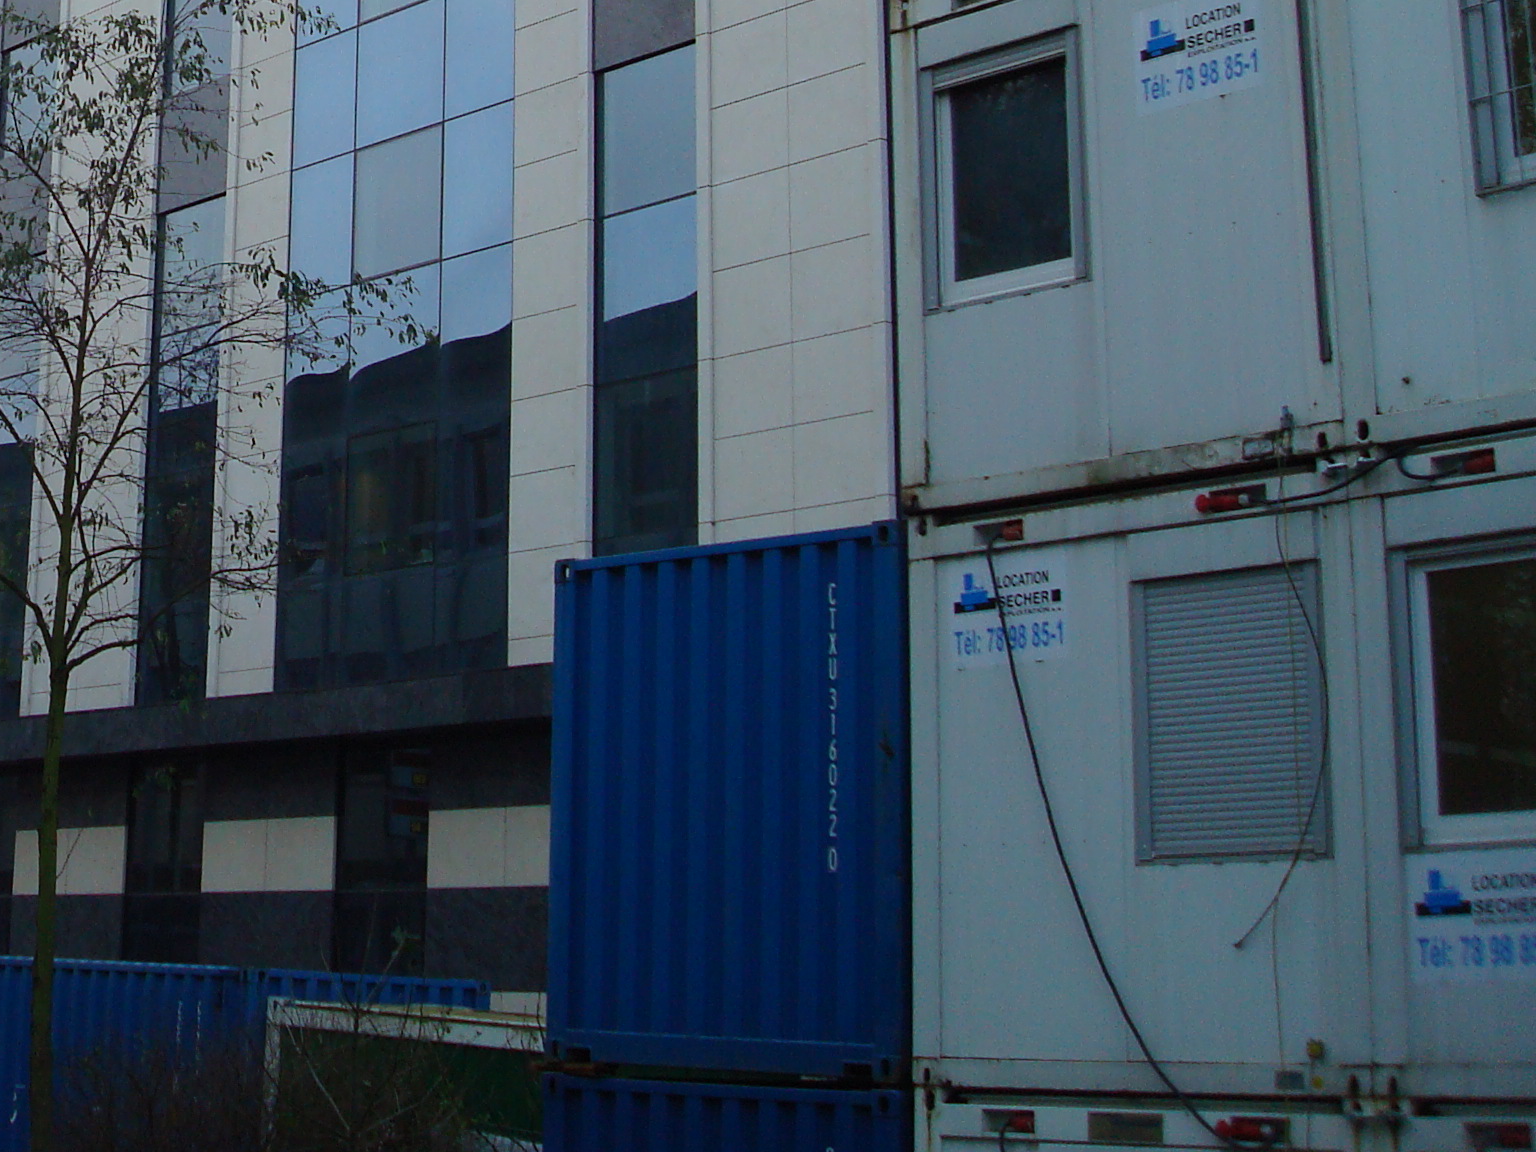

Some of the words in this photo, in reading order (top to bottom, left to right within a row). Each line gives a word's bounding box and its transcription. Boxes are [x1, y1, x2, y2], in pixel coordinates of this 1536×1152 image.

[1185, 2, 1241, 29] LOCATION
[1187, 22, 1242, 49] SECHER
[1141, 74, 1171, 102] Tél:
[1176, 66, 1195, 93] 78
[1199, 59, 1219, 86] 98
[1225, 48, 1258, 80] 85-1
[996, 570, 1049, 589] LOCATION
[998, 590, 1049, 607] SECHER
[828, 583, 837, 680] CTXU
[986, 626, 1005, 652] 78
[1009, 624, 1026, 650] 98
[1032, 619, 1063, 647] 85-1
[1459, 934, 1484, 966] 78
[1490, 934, 1514, 967] 98
